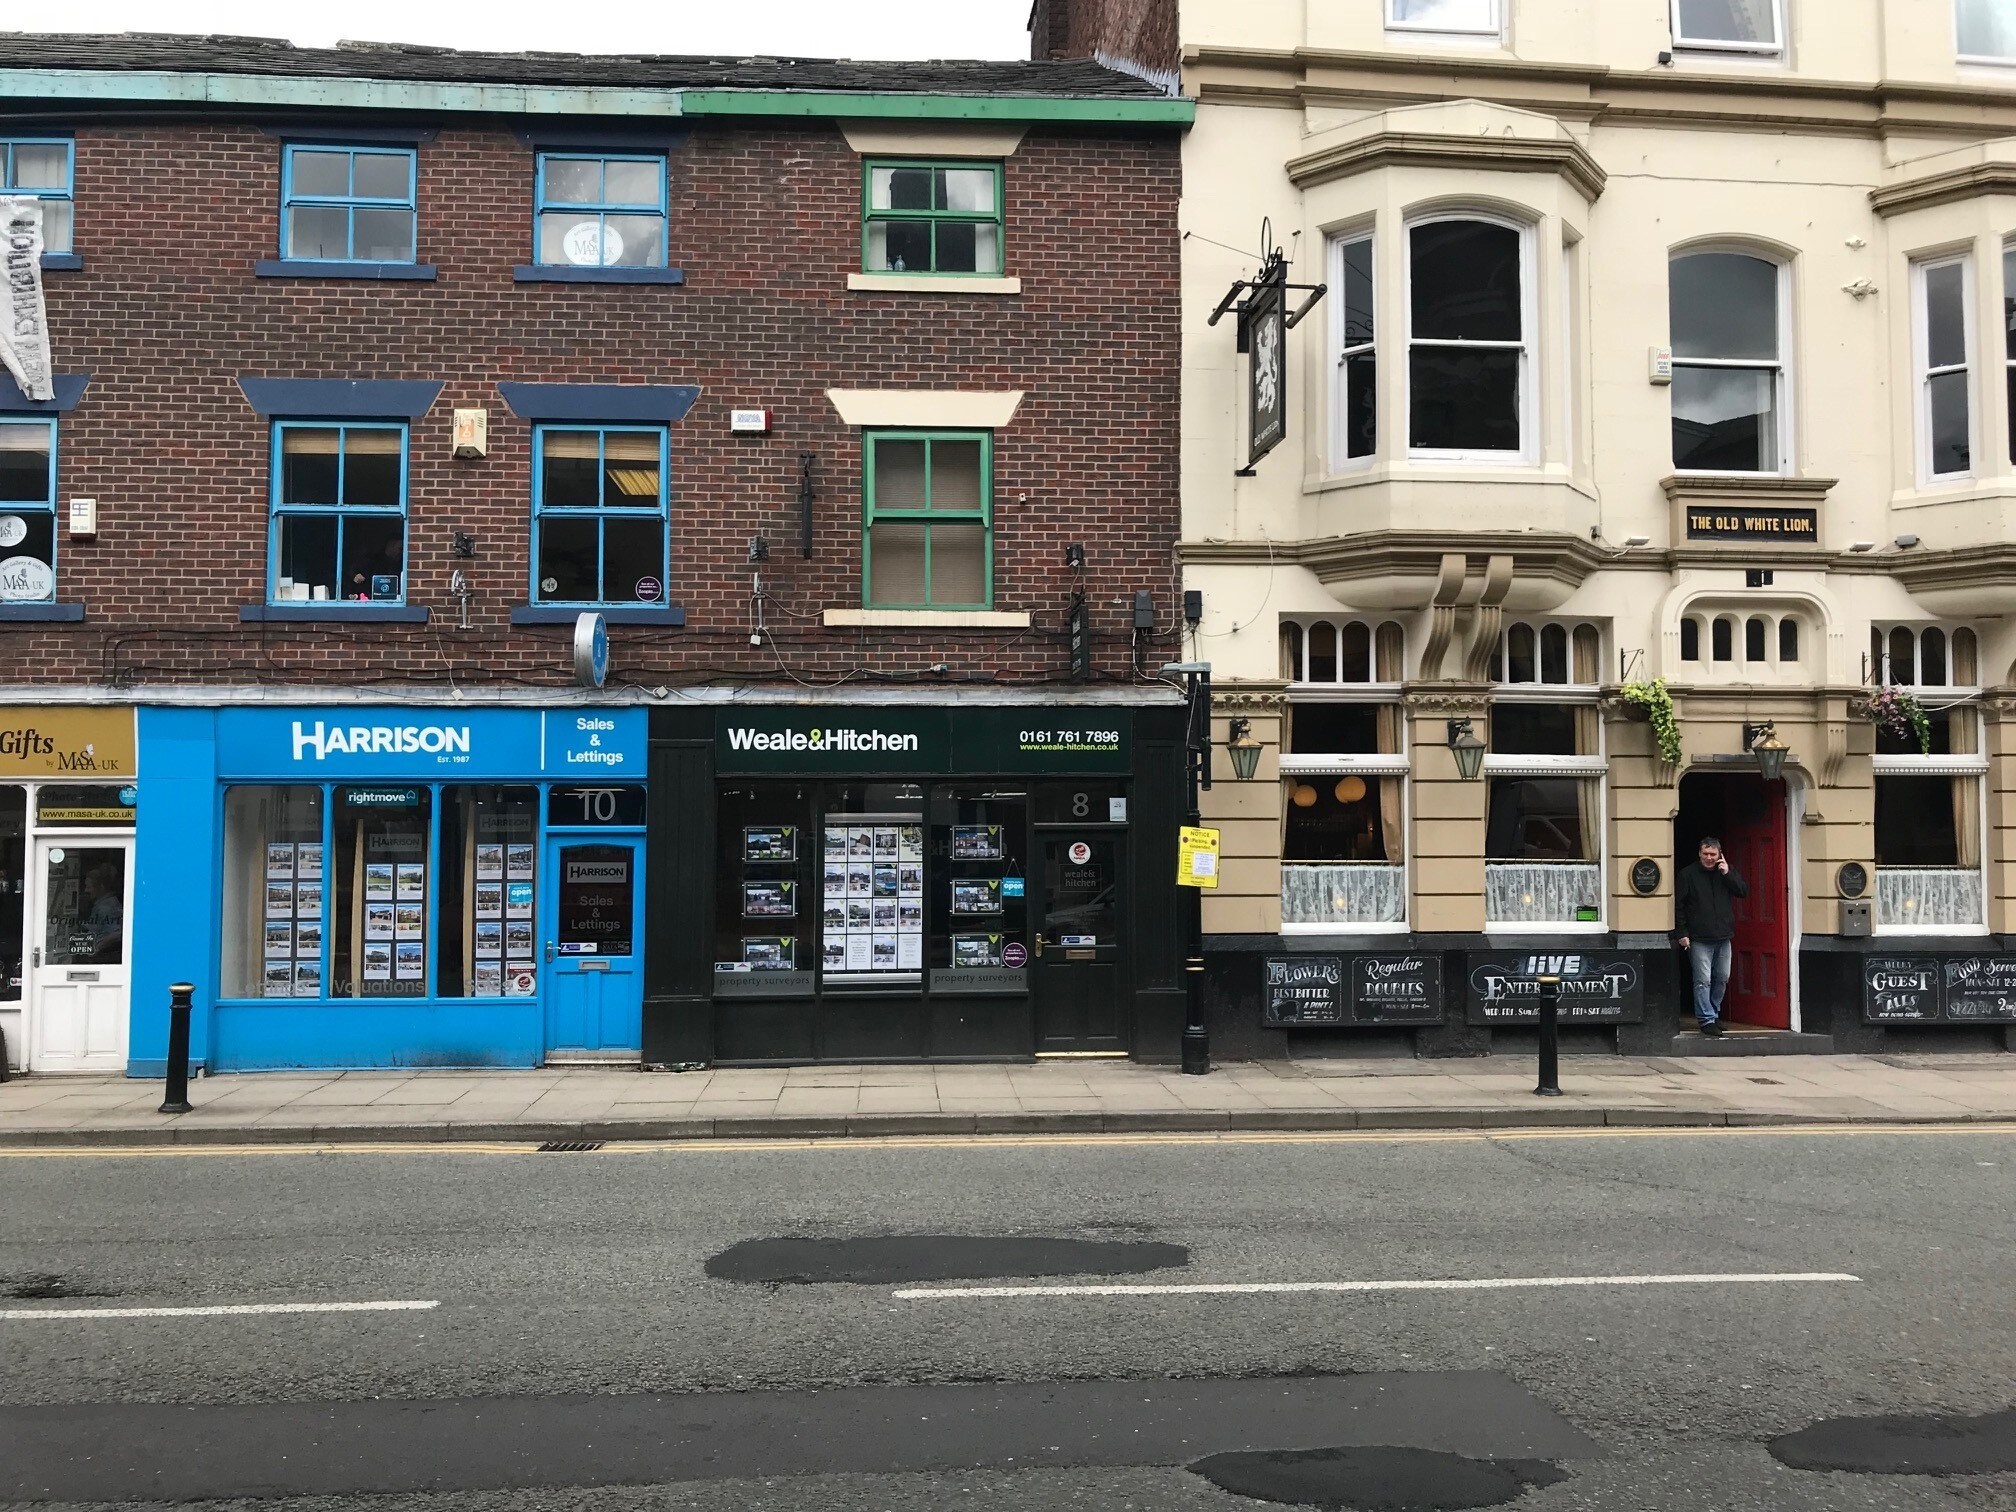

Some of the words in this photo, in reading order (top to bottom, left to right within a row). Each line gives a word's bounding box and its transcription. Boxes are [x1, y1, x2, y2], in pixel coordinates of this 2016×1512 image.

[7, 219, 39, 336] EXHIBITION
[1691, 516, 1712, 530] THE
[1715, 516, 1739, 531] OLD
[1744, 517, 1780, 532] WHITE
[1783, 518, 1814, 532] LION.
[576, 717, 615, 731] Sales
[292, 721, 470, 760] HARRISON
[589, 733, 602, 747] &
[1019, 730, 1052, 743] 0161
[1056, 730, 1080, 743] 761
[1085, 730, 1119, 743] 7896
[0, 728, 54, 760] Gifts
[1019, 743, 1119, 751] www.weale-hitchen.co.uk
[567, 749, 624, 766] Lettings
[348, 792, 406, 804] rightmove
[578, 789, 616, 821] 10
[1072, 792, 1090, 817] 8
[42, 809, 133, 818] www.masa-uk.co.uk
[1190, 830, 1210, 838] NOTICE
[570, 866, 624, 878] HARRISON
[1003, 882, 1024, 891] open
[1065, 878, 1096, 887] hitchen
[511, 887, 532, 898] open
[580, 895, 614, 906] Sales
[591, 907, 601, 918] &
[571, 919, 621, 932] Lettings
[1365, 956, 1424, 980] Regular
[719, 976, 762, 990] property
[764, 974, 810, 987] surveyors
[934, 974, 976, 985] property
[978, 972, 1023, 983] surveyors
[1872, 971, 1933, 991] GUEST
[333, 978, 425, 994] Valuations
[1364, 981, 1425, 996] DOUBLES
[1482, 973, 1628, 1000] ENTERAINMENT
